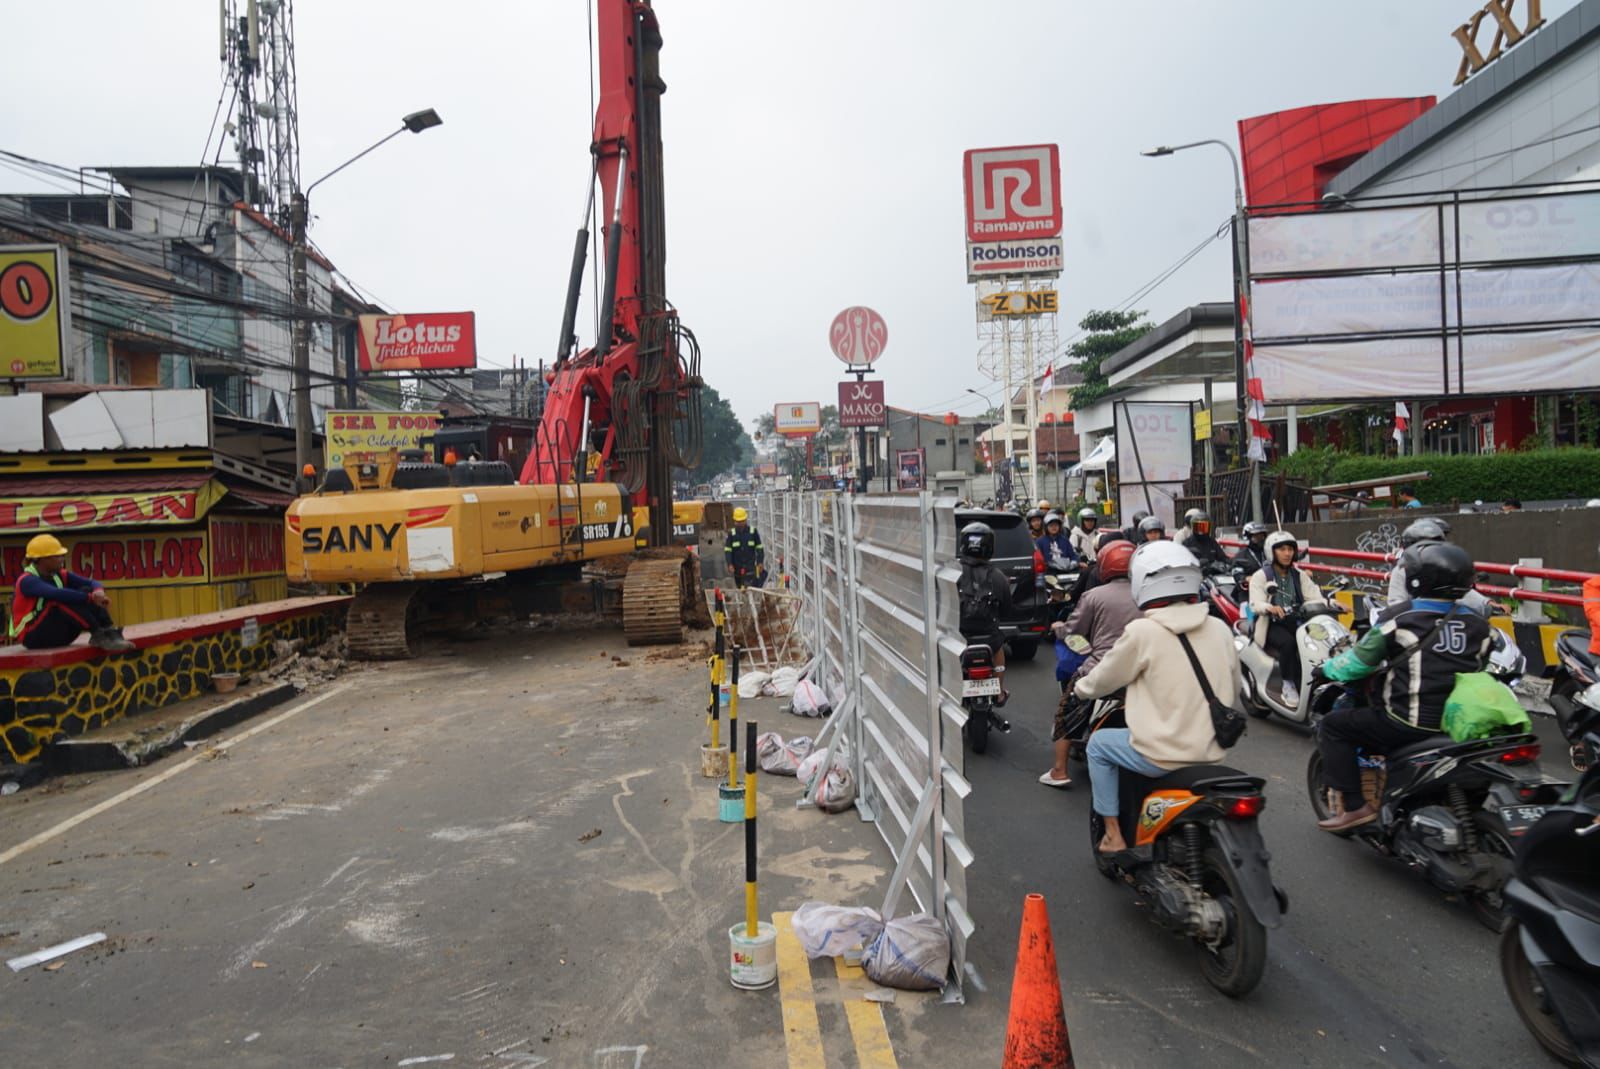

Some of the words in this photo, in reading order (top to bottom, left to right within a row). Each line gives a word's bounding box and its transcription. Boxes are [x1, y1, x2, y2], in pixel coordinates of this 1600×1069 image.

[973, 219, 1054, 234] Ramayana
[972, 243, 1061, 261] Robinson
[1026, 257, 1061, 269] mart
[376, 319, 462, 345] Lotus
[379, 343, 409, 361] fried
[410, 341, 456, 356] chicken
[842, 403, 884, 417] MAKO
[333, 416, 376, 430] SEA
[387, 416, 441, 430] FOOD
[302, 522, 404, 553] SANY
[583, 524, 609, 539] SR155
[71, 537, 205, 580] CIBALOK
